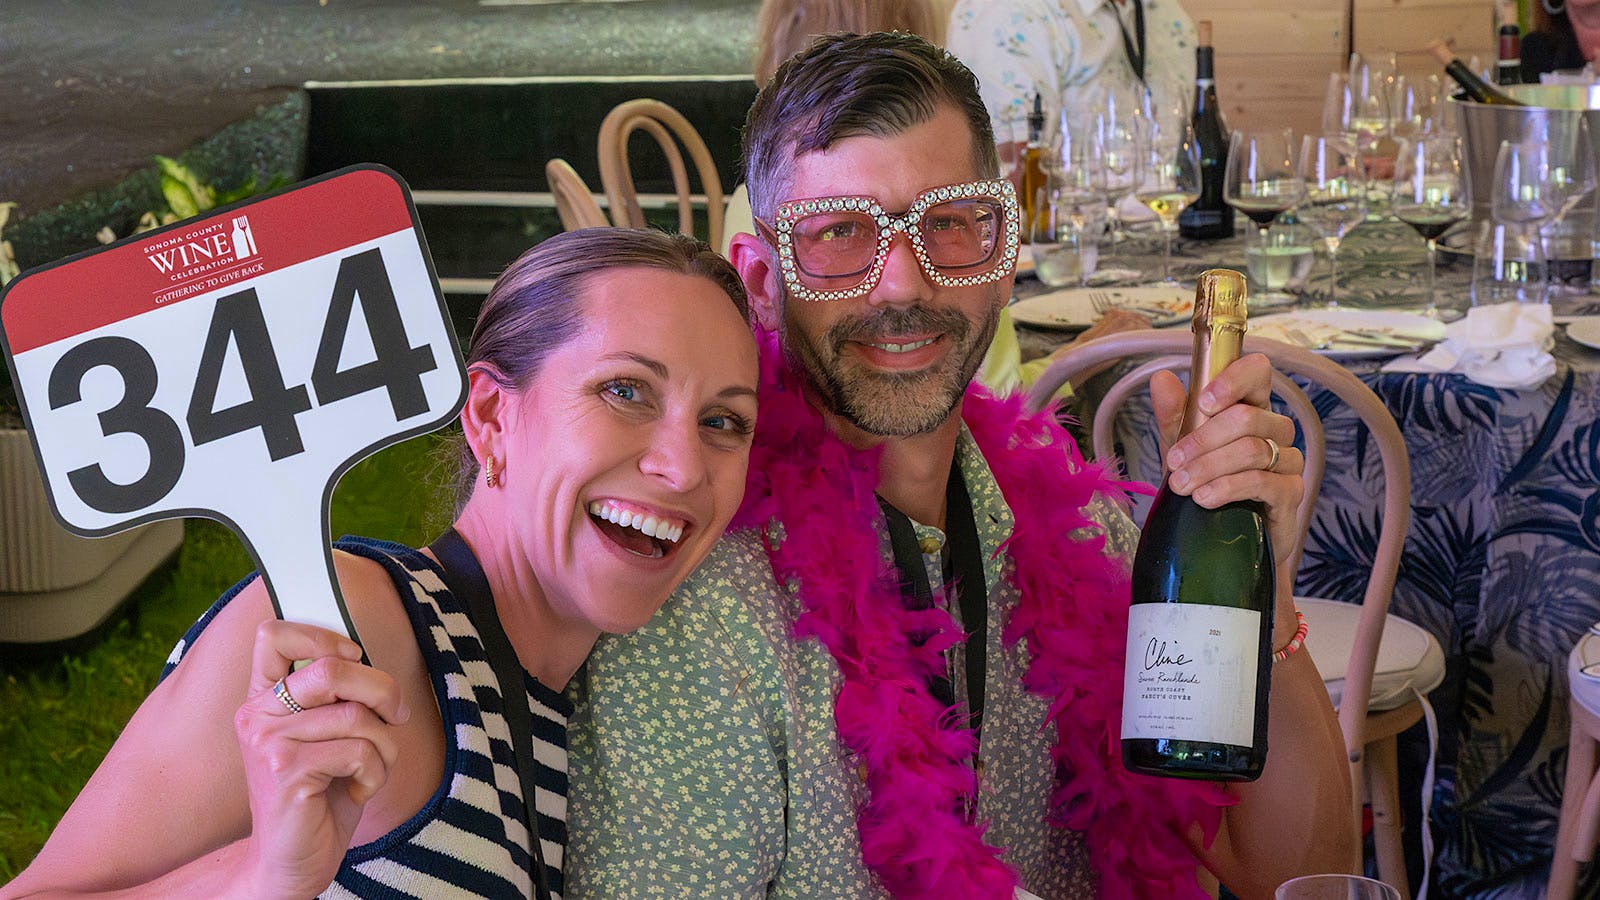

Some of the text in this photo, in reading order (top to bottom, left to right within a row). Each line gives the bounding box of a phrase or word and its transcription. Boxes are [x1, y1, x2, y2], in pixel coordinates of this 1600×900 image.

[143, 223, 223, 254] SONOMA COUNTY
[147, 232, 232, 275] WINE
[155, 263, 265, 304] GATHERING TO GIVE BACK
[170, 256, 234, 281] CELEBRATION
[48, 246, 438, 514] 344
[1209, 628, 1221, 636] 2021
[1144, 636, 1193, 671] Cline
